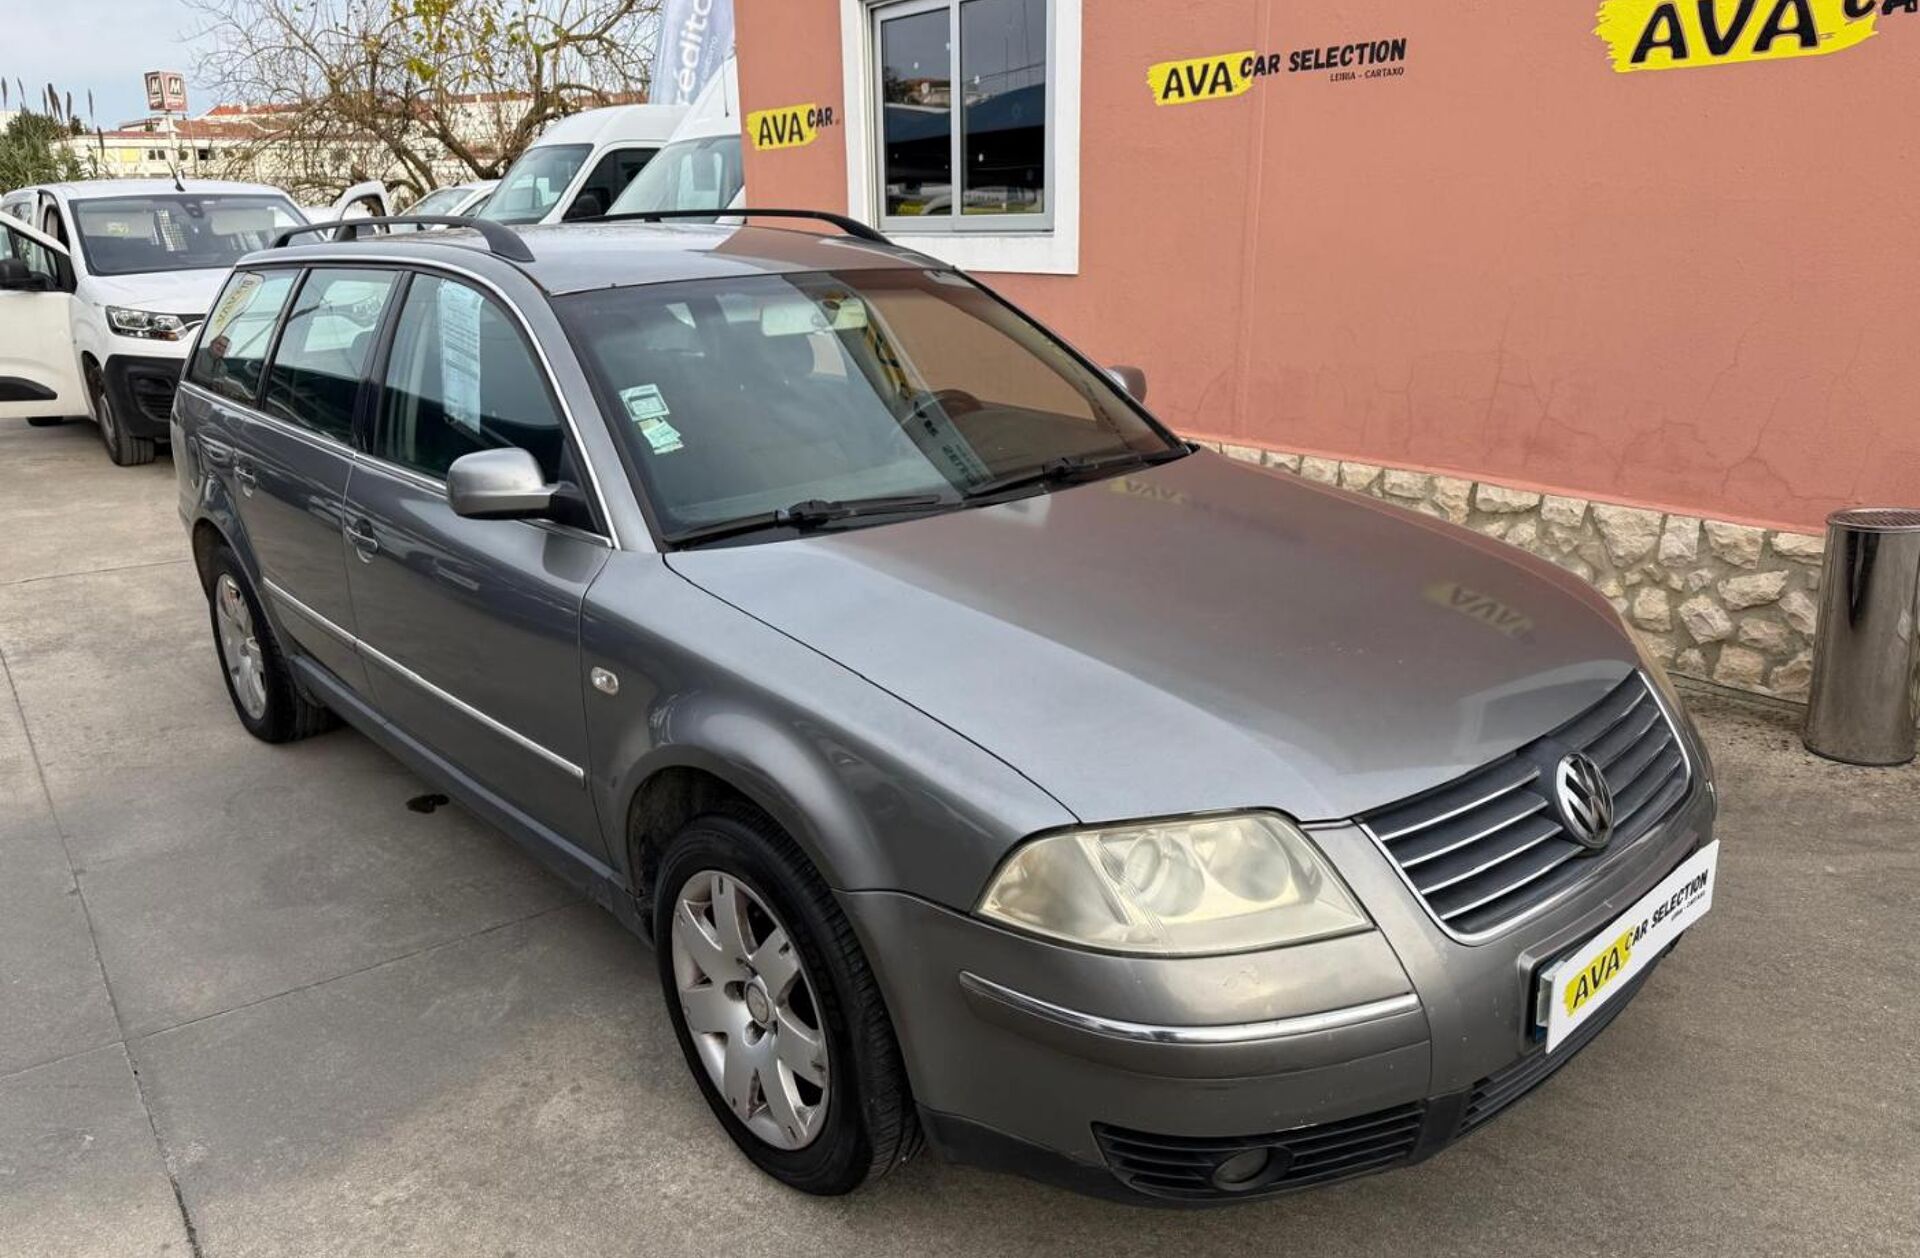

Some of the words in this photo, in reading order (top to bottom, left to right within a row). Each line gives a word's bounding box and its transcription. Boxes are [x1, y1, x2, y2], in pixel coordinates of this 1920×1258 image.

[1630, 0, 1818, 63] AVA
[1162, 62, 1233, 100] AVA
[1240, 53, 1281, 79] CAR
[1288, 38, 1407, 72] SELECTION
[1364, 67, 1404, 79] CARTAXO
[758, 112, 804, 146] AVA
[807, 107, 833, 128] CAR
[1573, 947, 1620, 1008] AVA
[1625, 921, 1648, 951] CAR
[1651, 869, 1708, 928] SELECTION
